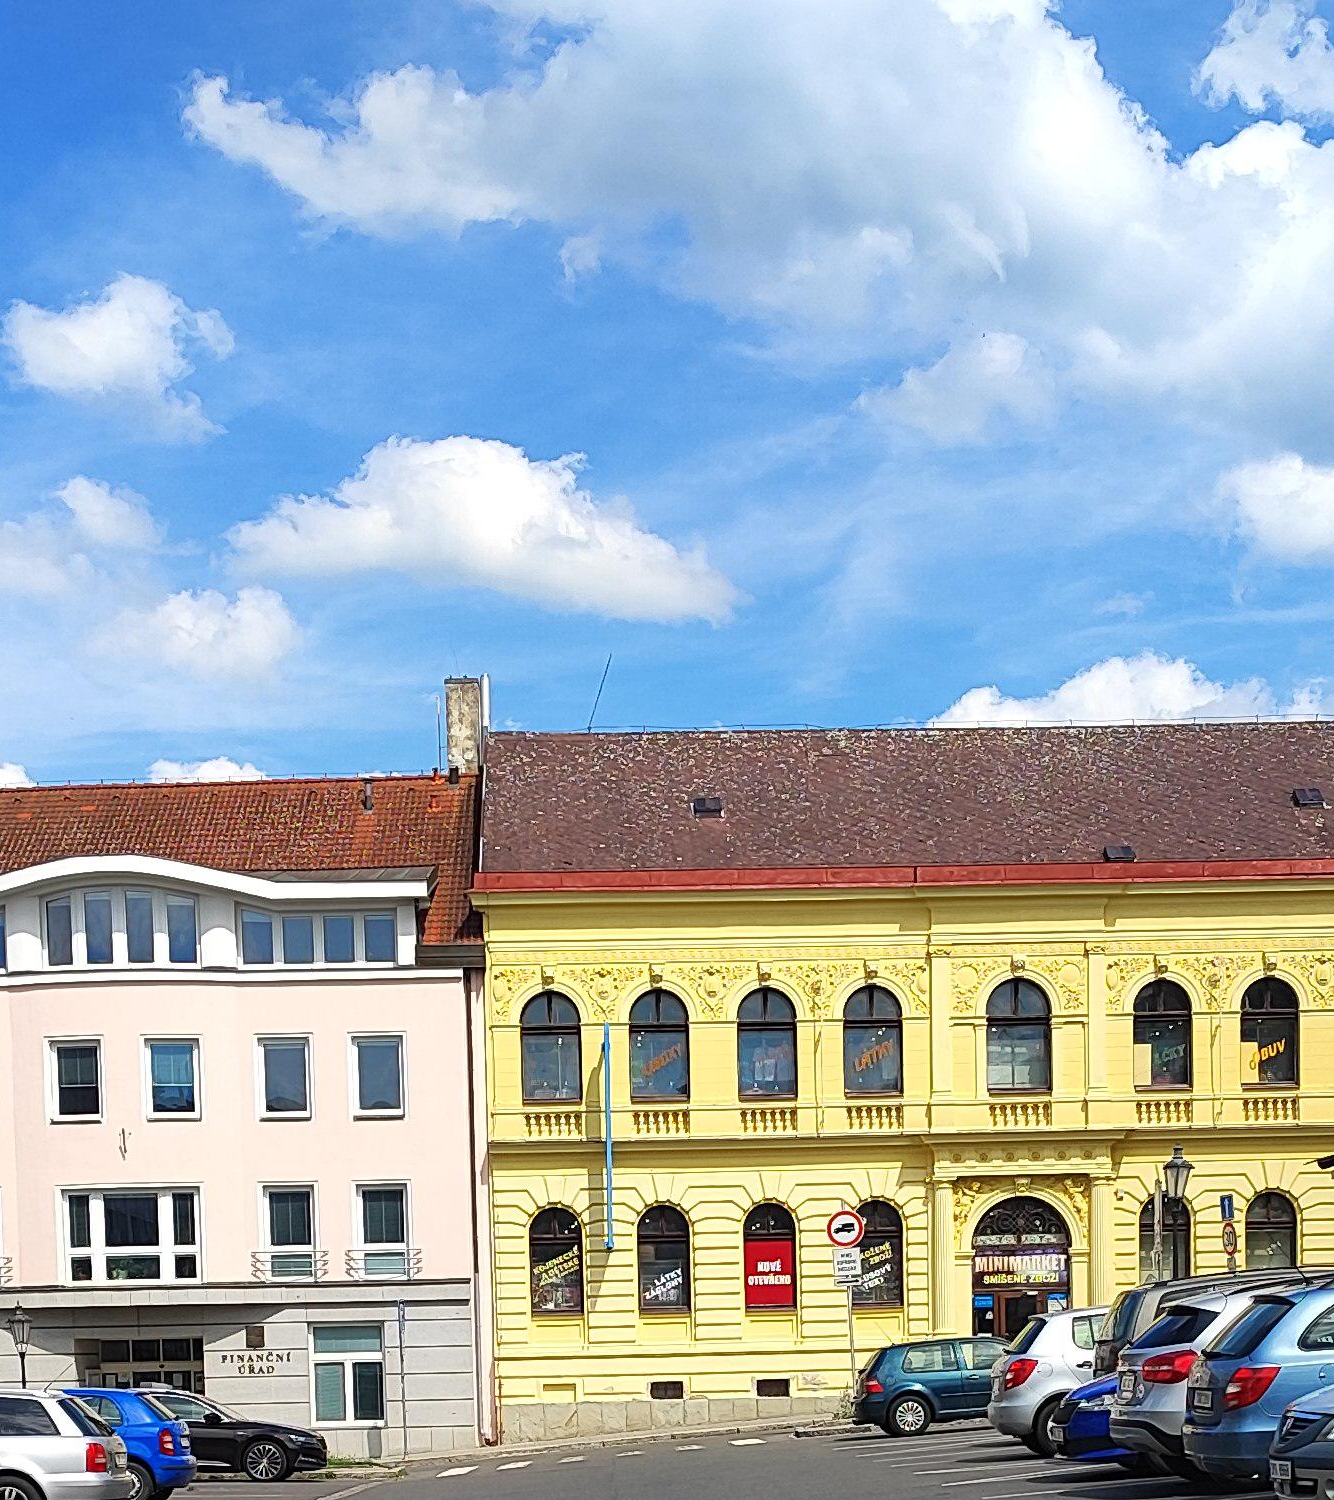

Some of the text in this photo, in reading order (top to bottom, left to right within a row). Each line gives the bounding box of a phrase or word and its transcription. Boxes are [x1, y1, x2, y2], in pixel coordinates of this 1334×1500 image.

[757, 1259, 782, 1272] NOVÉ
[975, 1254, 1068, 1272] MINIMARKET
[653, 1267, 682, 1286] LÁTKY
[748, 1273, 792, 1286] OTEVŘENO
[221, 1352, 291, 1363] FINANČNÍ
[238, 1364, 275, 1375] ÚŘAD
